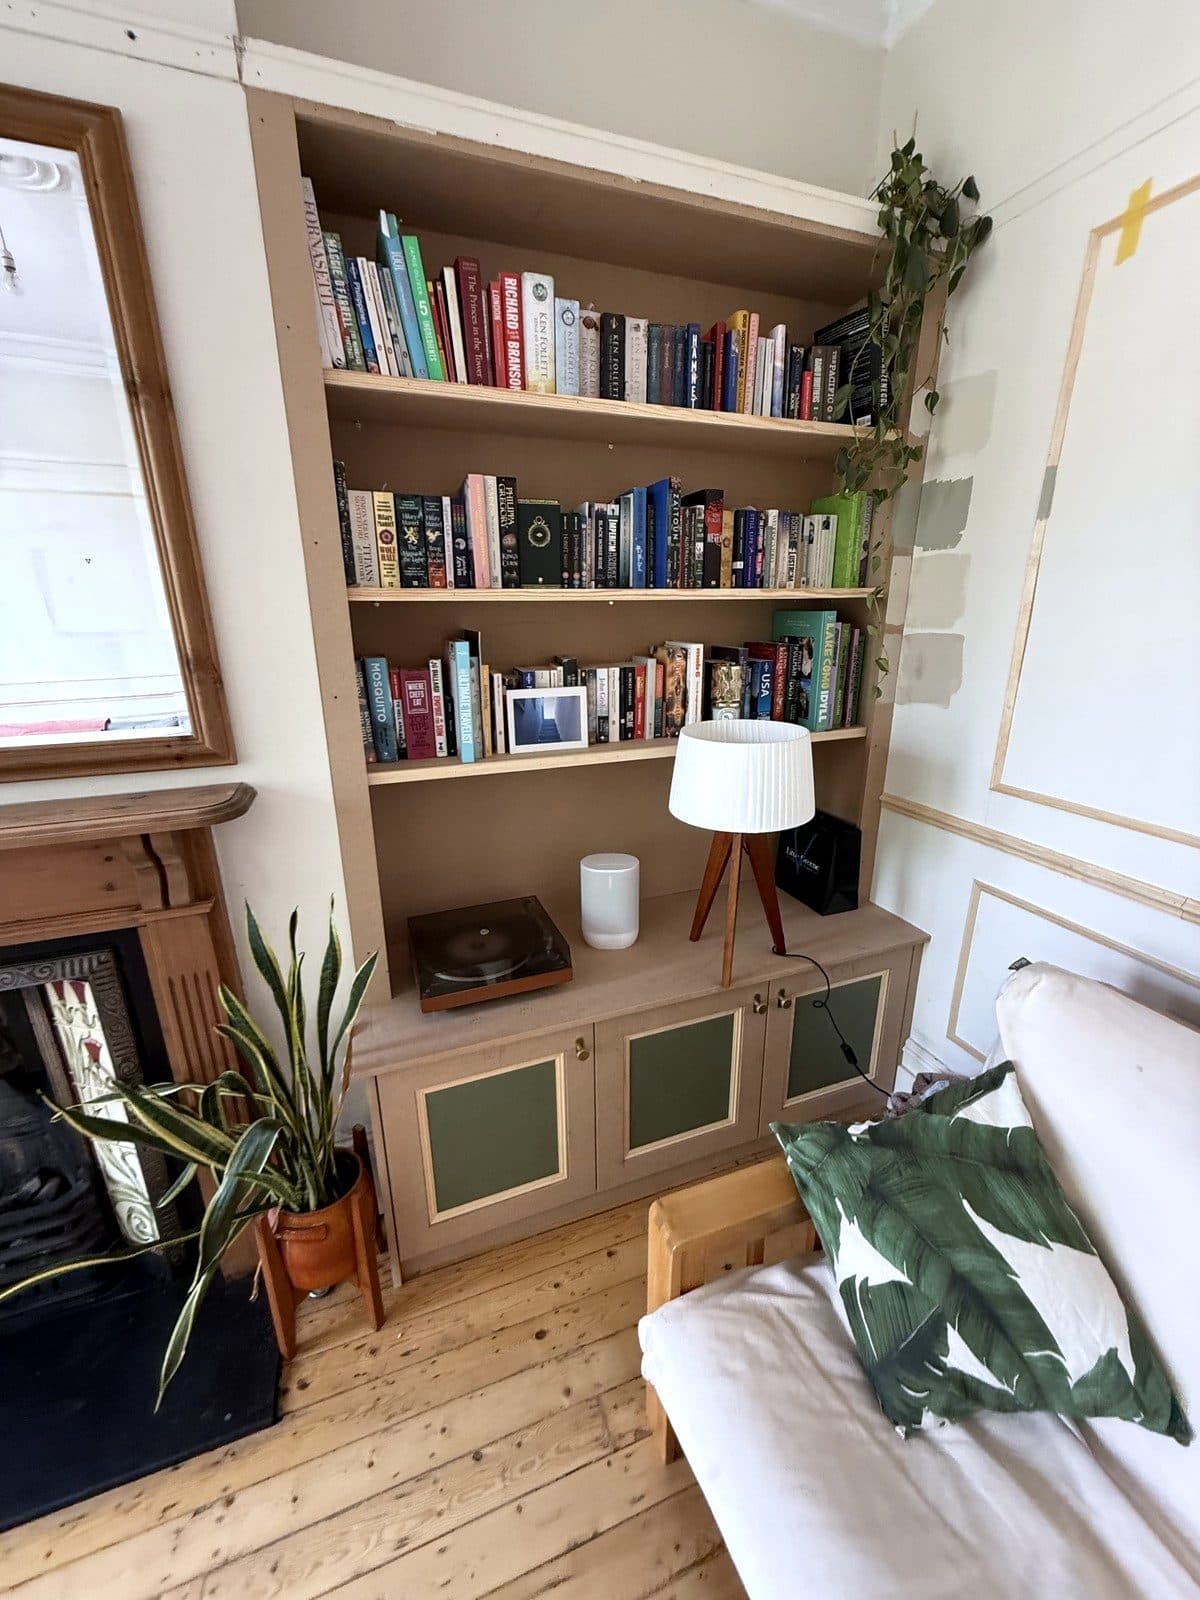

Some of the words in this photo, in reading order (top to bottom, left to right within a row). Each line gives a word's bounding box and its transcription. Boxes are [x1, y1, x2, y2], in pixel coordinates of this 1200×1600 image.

[304, 201, 334, 307] FORNASETTI
[327, 238, 341, 275] MAGGIE
[335, 280, 352, 328] O'FARRELL
[468, 275, 476, 292] The
[353, 282, 368, 326] Philippines
[415, 300, 427, 316] 5
[470, 294, 478, 324] Princes
[492, 290, 500, 320] LONDON
[504, 278, 519, 329] RICHARD
[472, 327, 479, 335] in
[474, 338, 482, 351] the
[475, 354, 483, 378] Tower
[540, 336, 548, 378] FOLLETT
[827, 364, 836, 404] PACIFIC
[499, 484, 507, 527] GREGORY
[506, 487, 514, 524] PHILIPPA
[608, 520, 618, 552] IMPERIUM
[362, 543, 375, 583] TITANS
[824, 623, 834, 657] LAKE
[761, 674, 771, 697] USA
[821, 659, 831, 689] COMO
[371, 663, 386, 722] MOSQUITO
[459, 675, 469, 707] ULTIMATE
[819, 691, 828, 722] IDYLL
[460, 709, 472, 745] TRAVELIST
